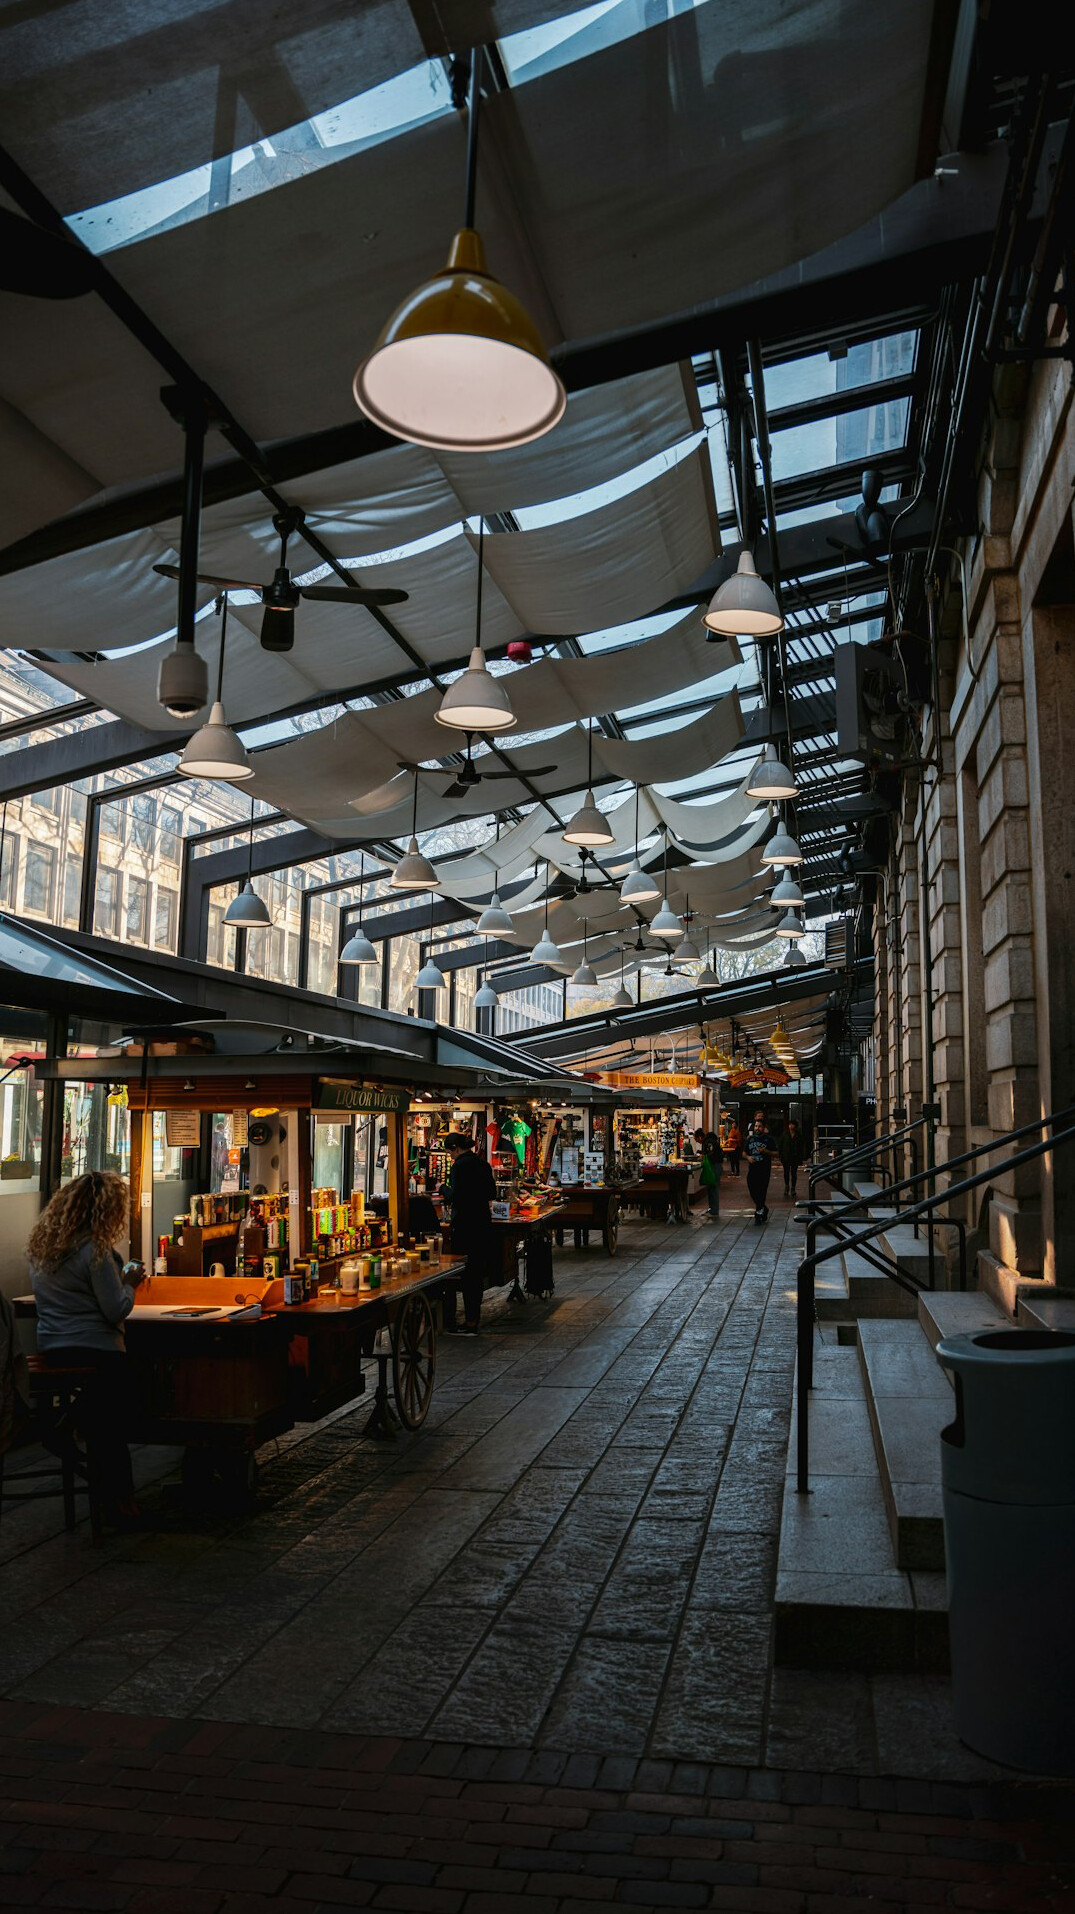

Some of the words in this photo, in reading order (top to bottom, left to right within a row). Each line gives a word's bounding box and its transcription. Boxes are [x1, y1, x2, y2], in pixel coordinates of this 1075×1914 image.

[625, 1076, 639, 1084] THE
[642, 1076, 669, 1085] BOSTON
[336, 1089, 373, 1108] LIQUOR
[373, 1092, 400, 1108] WICKS
